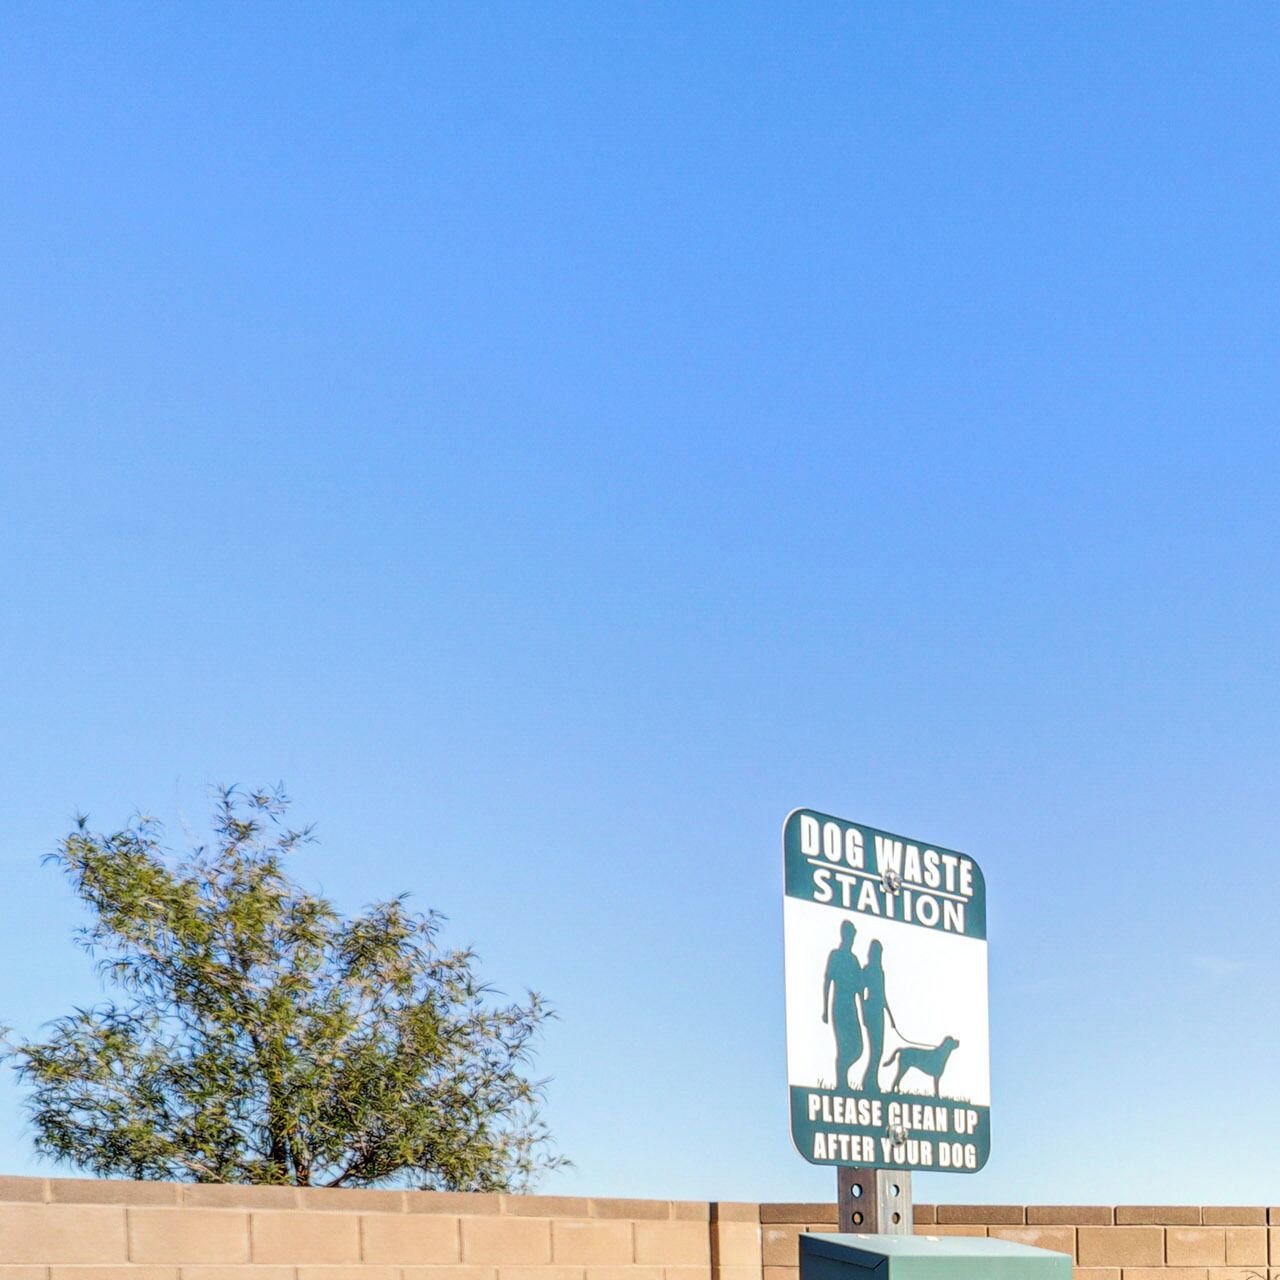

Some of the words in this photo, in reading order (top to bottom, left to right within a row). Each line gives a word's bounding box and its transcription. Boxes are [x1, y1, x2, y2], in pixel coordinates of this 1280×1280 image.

[800, 814, 864, 869] DOG
[874, 835, 973, 896] WASTE
[813, 868, 965, 934] STATION
[807, 1093, 882, 1127] PLEASE
[888, 1101, 948, 1132] CLEAN
[953, 1108, 978, 1135] UP
[813, 1132, 876, 1162] AFTER
[880, 1137, 933, 1166] YOUR
[938, 1142, 977, 1169] DOG
